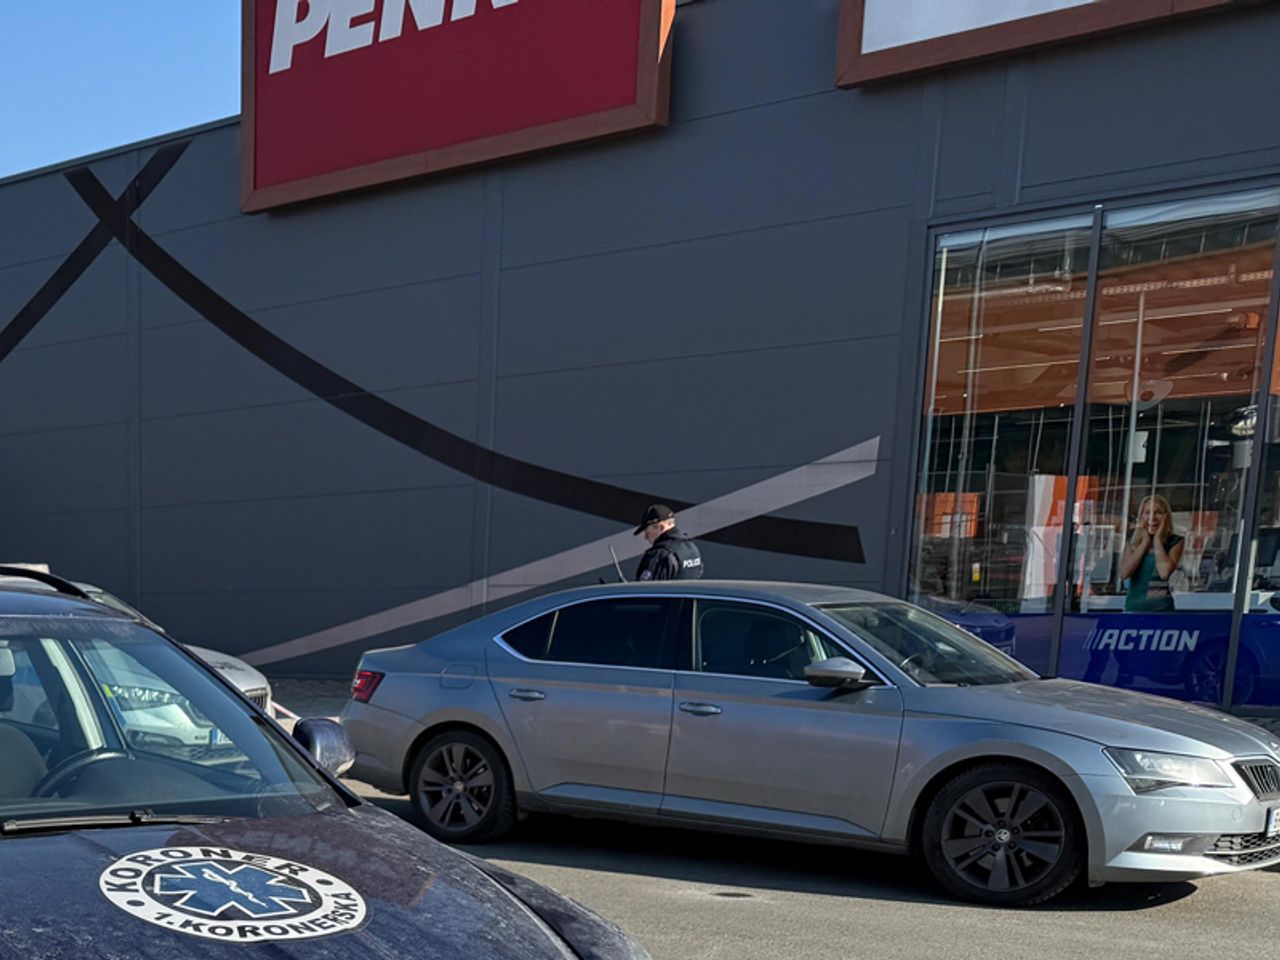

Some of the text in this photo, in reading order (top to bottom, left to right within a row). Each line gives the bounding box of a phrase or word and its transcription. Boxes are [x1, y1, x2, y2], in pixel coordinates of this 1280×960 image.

[269, 0, 519, 75] PE
[1098, 629, 1200, 651] ACTION
[104, 848, 310, 893] KORONER
